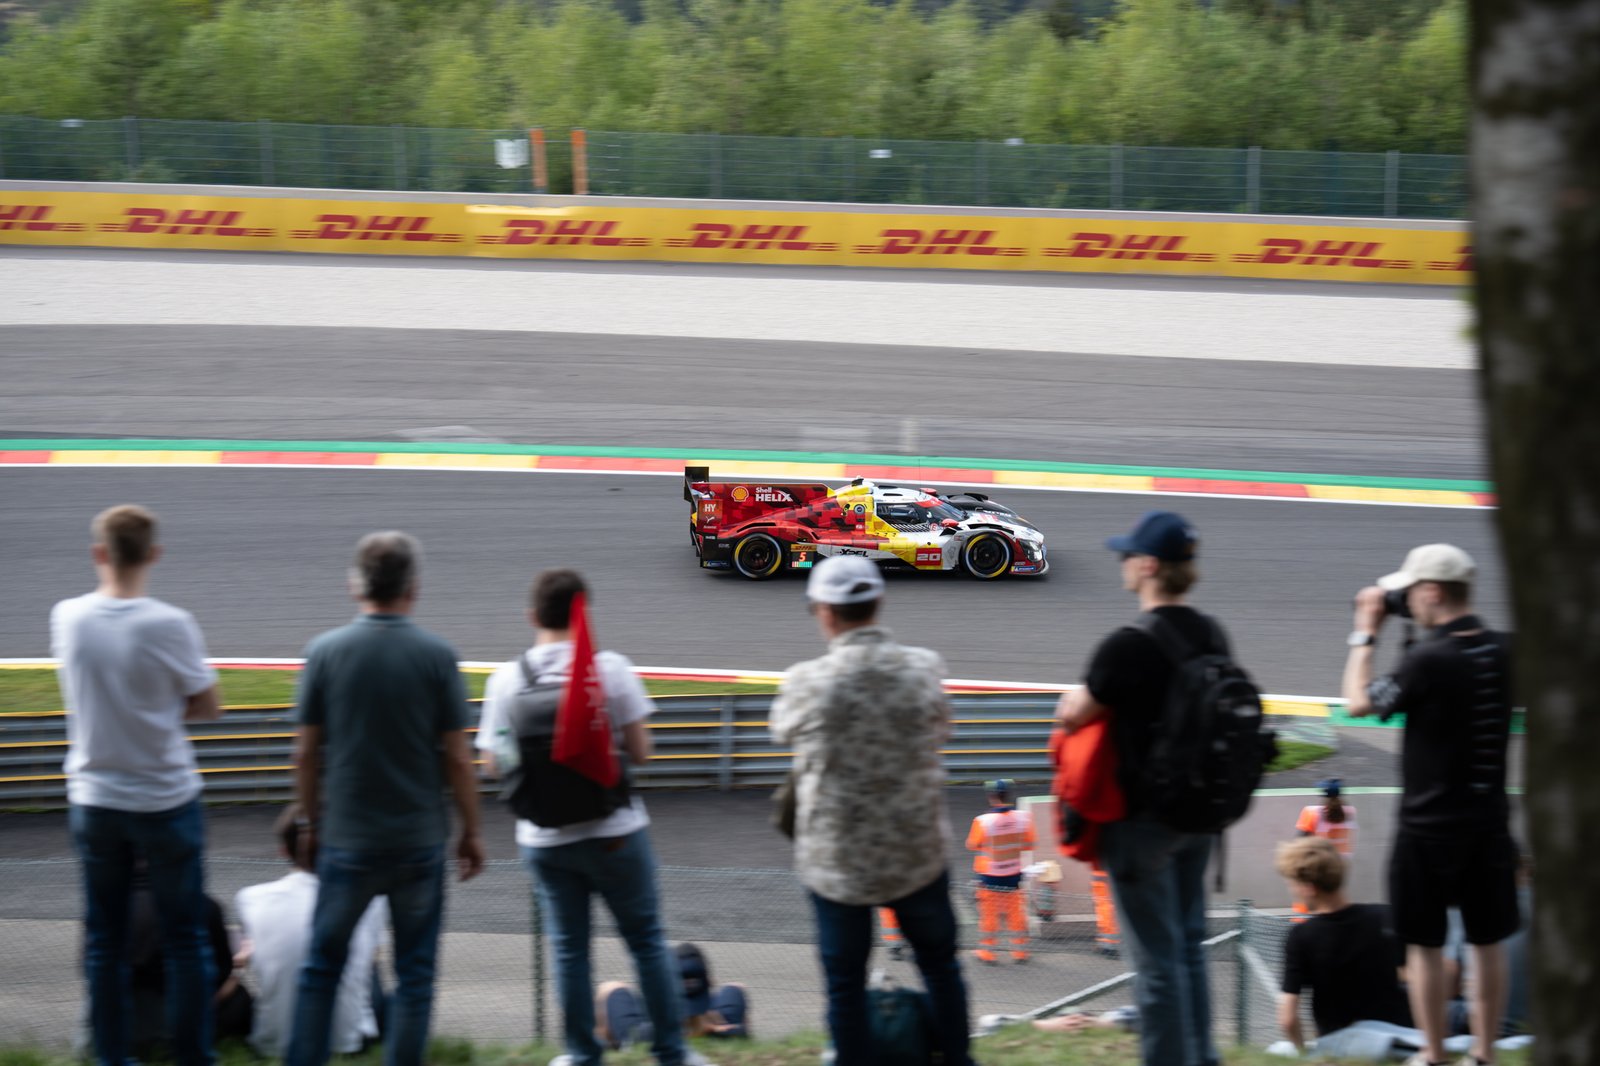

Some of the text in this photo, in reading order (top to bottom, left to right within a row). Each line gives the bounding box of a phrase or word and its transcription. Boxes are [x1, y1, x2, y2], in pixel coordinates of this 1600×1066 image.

[123, 208, 247, 237] DHL
[313, 214, 435, 242] DHL
[502, 219, 624, 246] DHL
[689, 223, 812, 251] DHL
[880, 228, 999, 257] DHL
[1068, 232, 1189, 261] DHL
[1259, 238, 1387, 268] DHL
[755, 486, 772, 494] Shell
[755, 491, 794, 502] HELIX
[704, 503, 716, 512] HY
[799, 552, 807, 562] 5
[916, 553, 941, 561] 20
